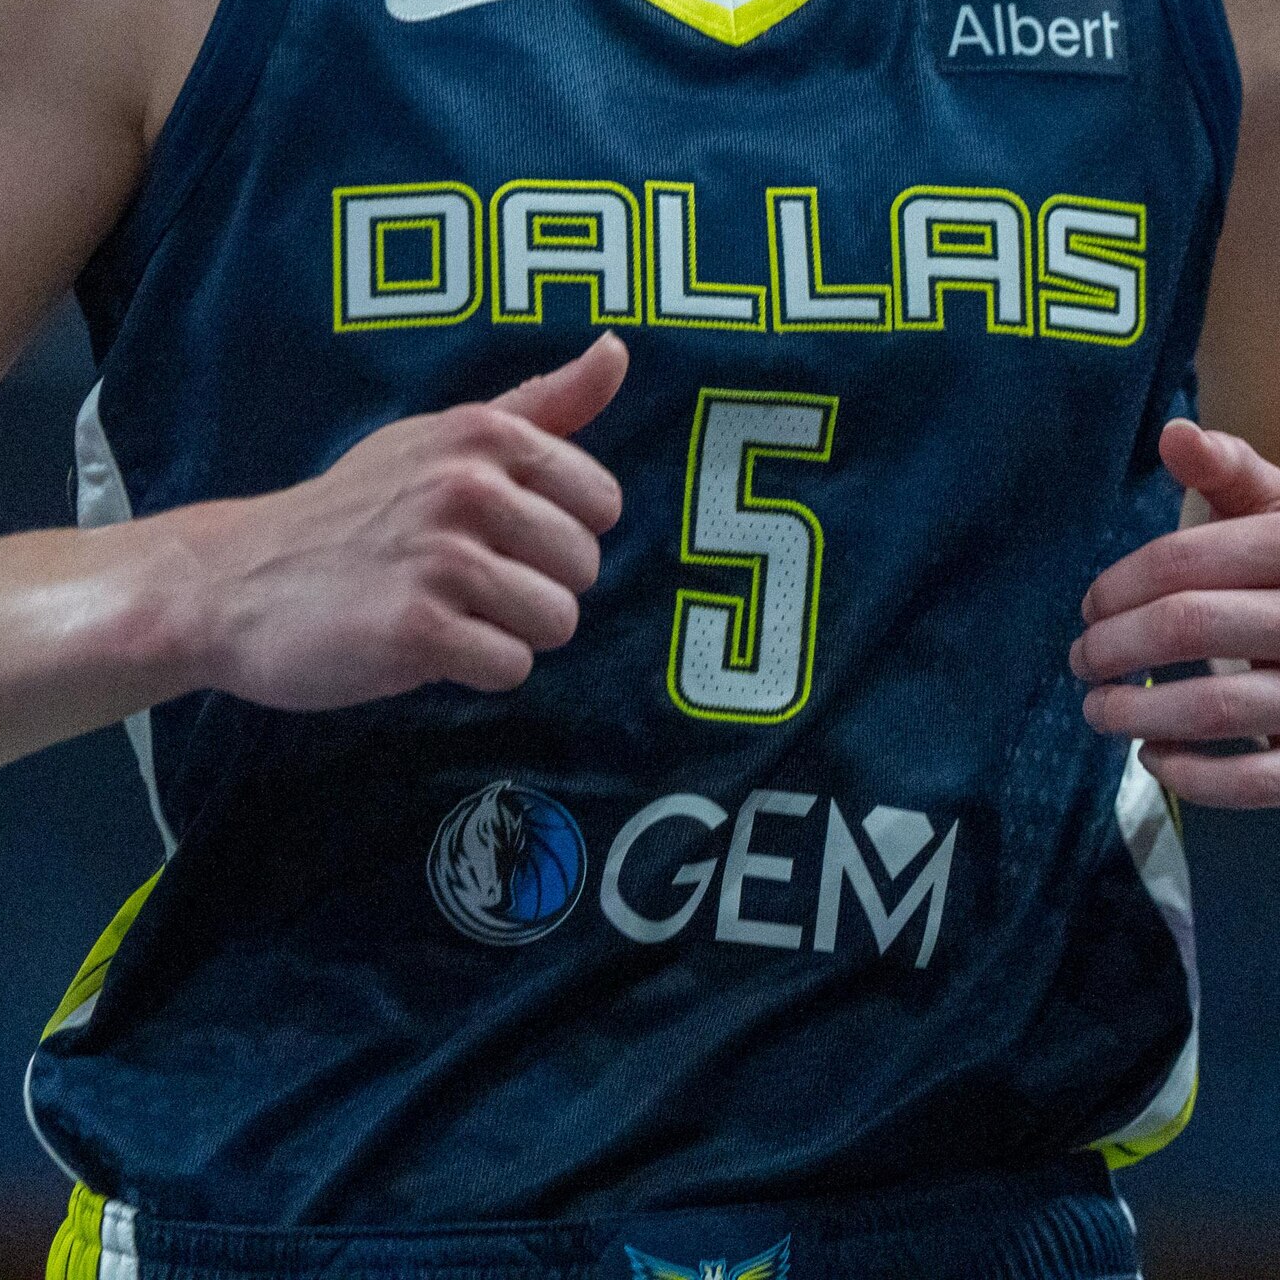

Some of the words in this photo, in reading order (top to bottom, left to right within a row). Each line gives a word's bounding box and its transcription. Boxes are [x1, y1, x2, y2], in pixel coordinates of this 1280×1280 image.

[948, 3, 1119, 59] Albert
[333, 179, 1146, 347] DALLAS
[667, 387, 840, 724] 5
[600, 789, 959, 969] GEM
